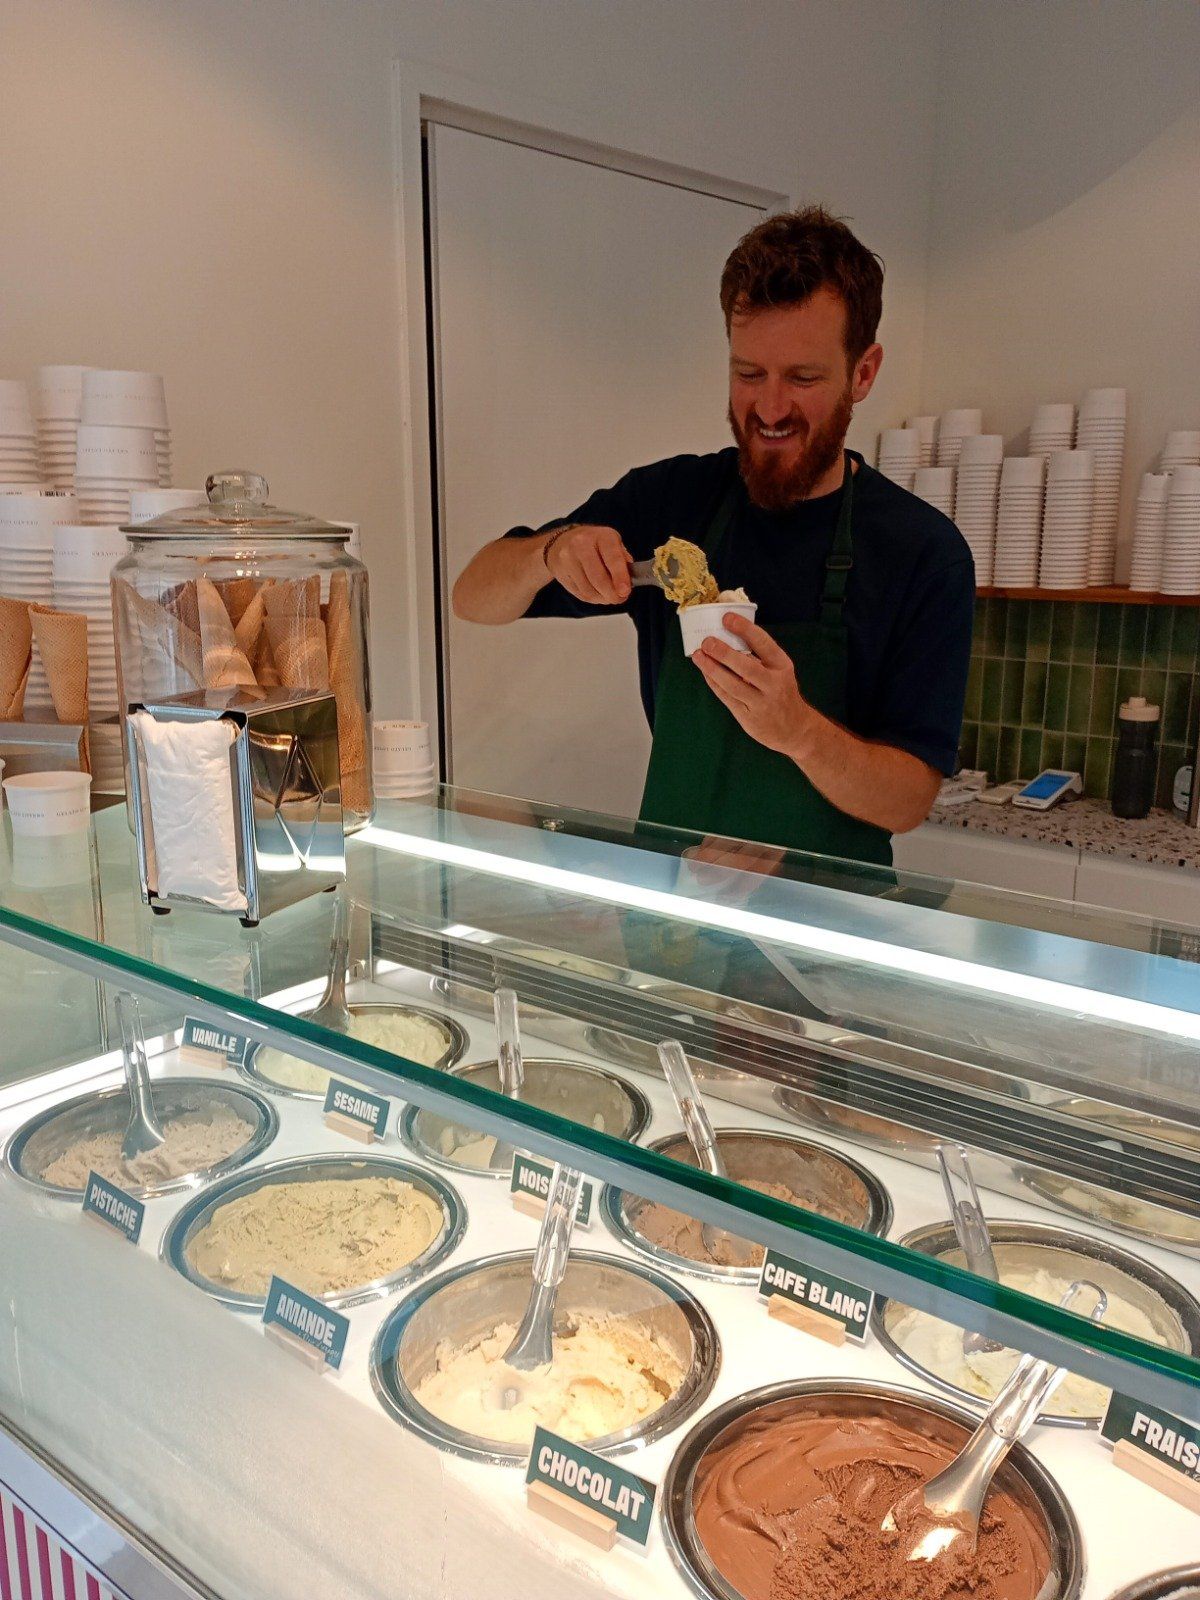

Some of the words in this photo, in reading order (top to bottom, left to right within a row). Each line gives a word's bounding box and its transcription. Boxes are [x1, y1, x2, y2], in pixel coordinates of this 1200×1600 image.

[192, 1026, 237, 1053] VANILLE
[333, 1090, 380, 1124] SESAME
[90, 1184, 138, 1231] PISTACHE
[518, 1166, 585, 1210] NOISE
[764, 1262, 808, 1298] CAFE
[808, 1281, 867, 1323] BLANC
[275, 1293, 336, 1348] AMANDE
[538, 1445, 645, 1521] CHOCOLAT
